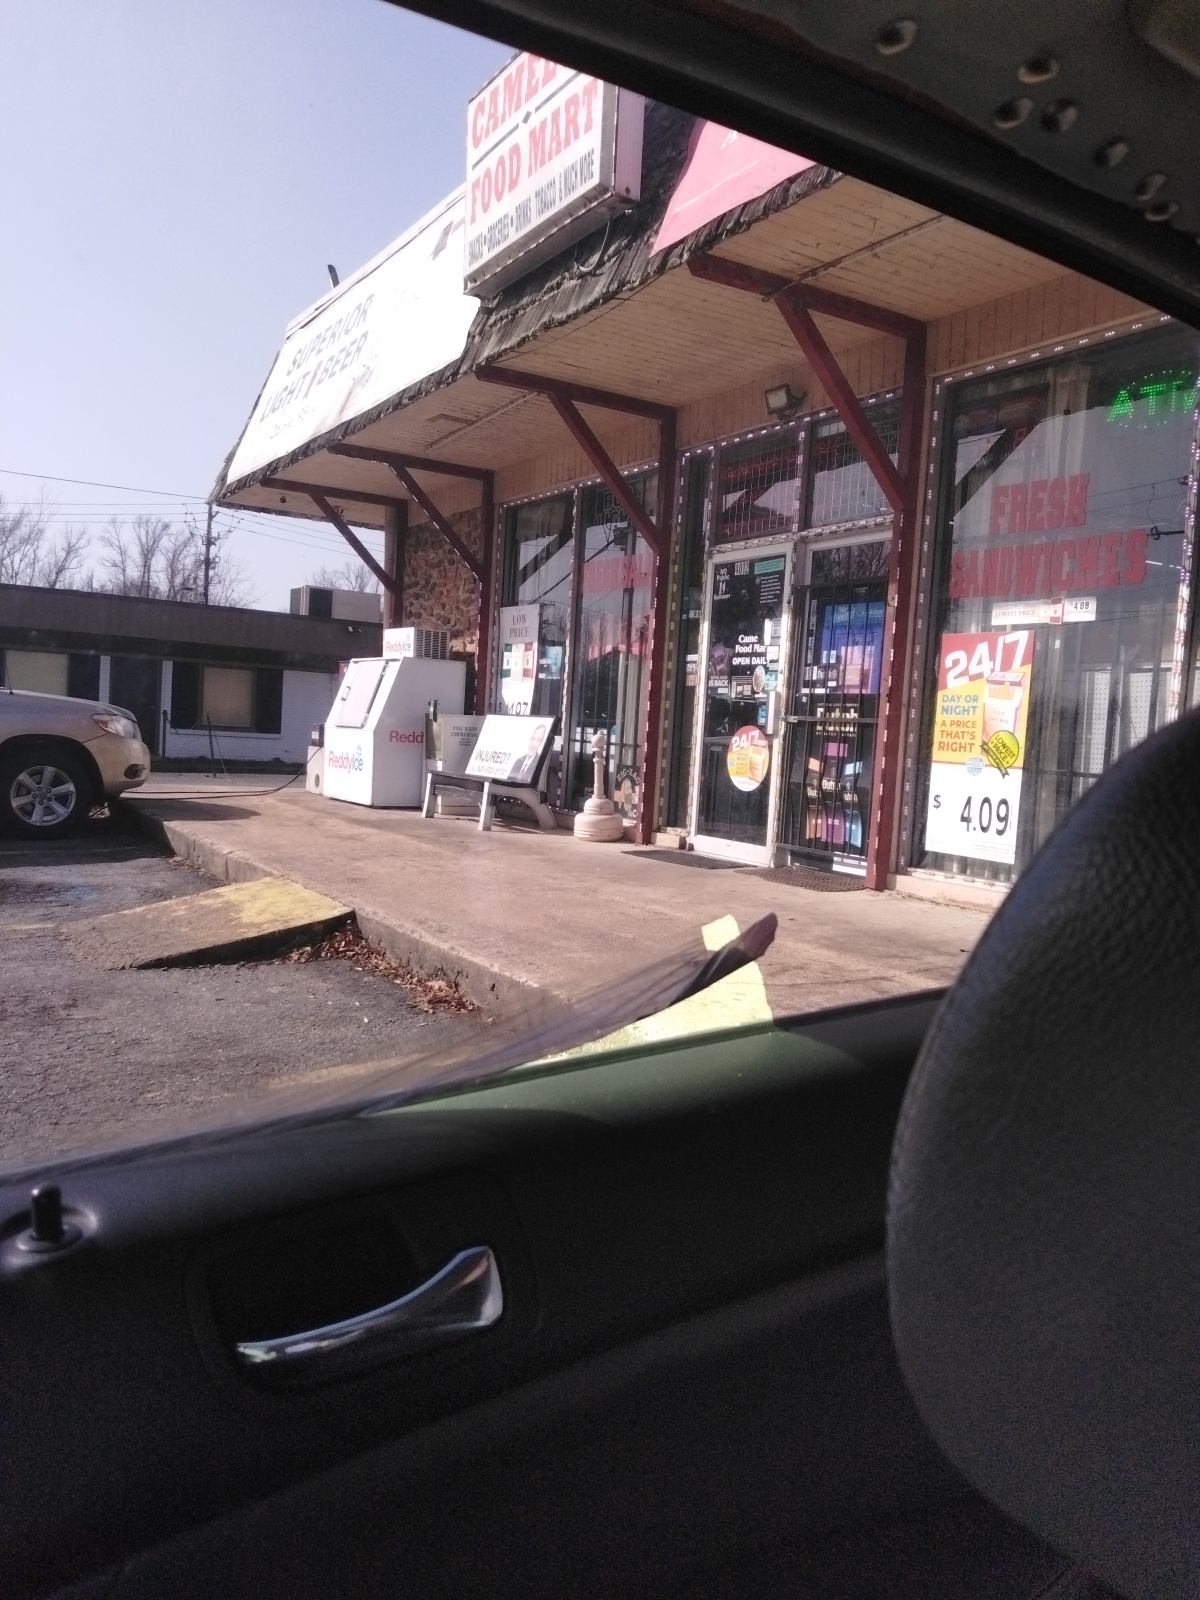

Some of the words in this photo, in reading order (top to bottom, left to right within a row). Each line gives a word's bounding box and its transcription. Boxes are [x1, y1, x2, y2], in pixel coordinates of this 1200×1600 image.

[470, 142, 521, 226] FOOD
[528, 79, 598, 178] MART
[487, 212, 509, 253] GROCERIES
[535, 177, 556, 219] TOBACCO
[564, 159, 578, 200] MUCH
[580, 147, 594, 188] MORE
[286, 292, 375, 377] SUPERIOR
[259, 369, 311, 423] LIGHT
[316, 330, 369, 386] BEER
[990, 472, 1090, 535] FRESH
[949, 528, 1148, 599] SANDWICHES
[512, 614, 528, 626] LOW
[509, 626, 529, 639] PRICE
[735, 644, 752, 653] Food
[753, 644, 767, 653] Mar
[732, 657, 750, 665] OPEN
[945, 631, 1029, 689] 24/7
[941, 695, 963, 703] DAY
[964, 694, 979, 704] OR
[941, 705, 978, 716] NIGHT
[949, 720, 977, 729] PRICE
[389, 730, 425, 744] Redd
[940, 730, 976, 740] THAT'S
[937, 741, 976, 753] RIGHT
[992, 743, 1008, 762] PRICE
[994, 734, 1016, 759] LOWEST
[474, 749, 511, 765] INJURED?
[933, 794, 942, 809] $
[960, 795, 1010, 836] 4.09
